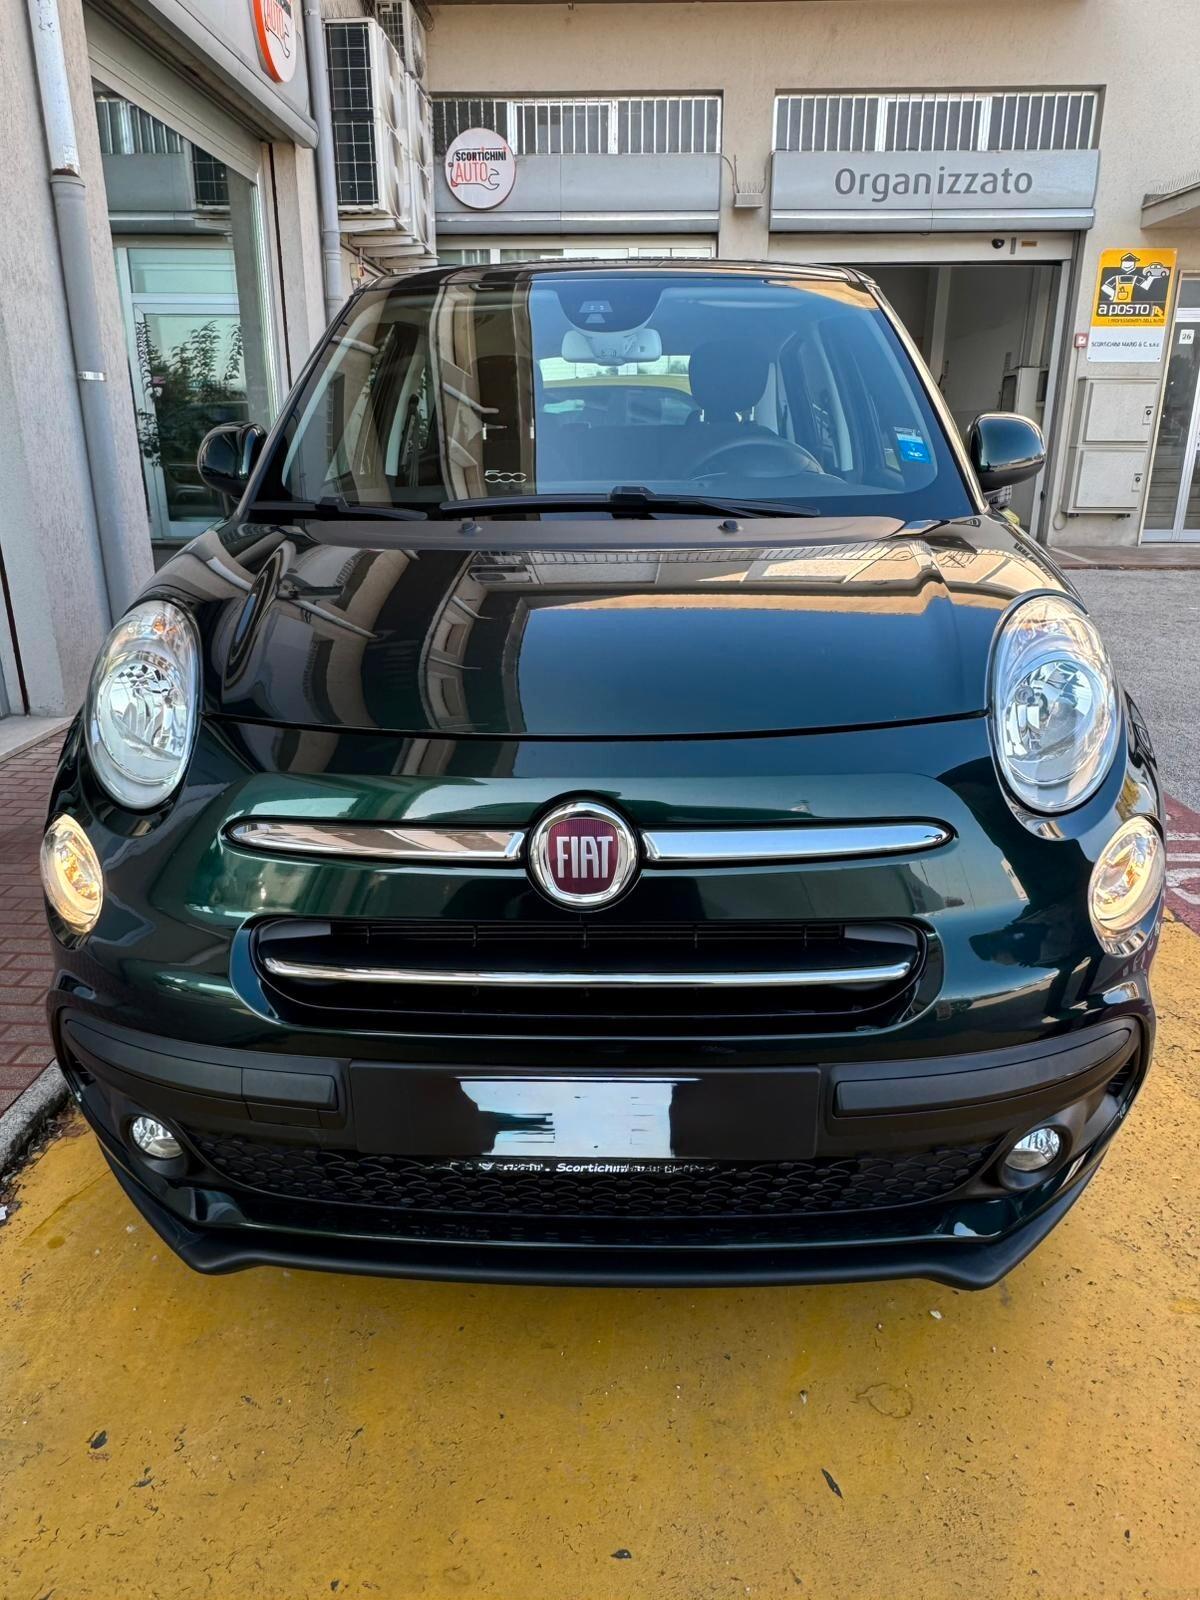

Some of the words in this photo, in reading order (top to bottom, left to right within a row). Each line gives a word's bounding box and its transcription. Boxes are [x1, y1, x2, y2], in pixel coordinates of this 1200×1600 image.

[455, 151, 507, 161] SCORTICHINI
[455, 162, 488, 182] AUTO
[835, 166, 1033, 203] Organizzato
[485, 469, 527, 483] 500
[556, 836, 614, 879] FIAT
